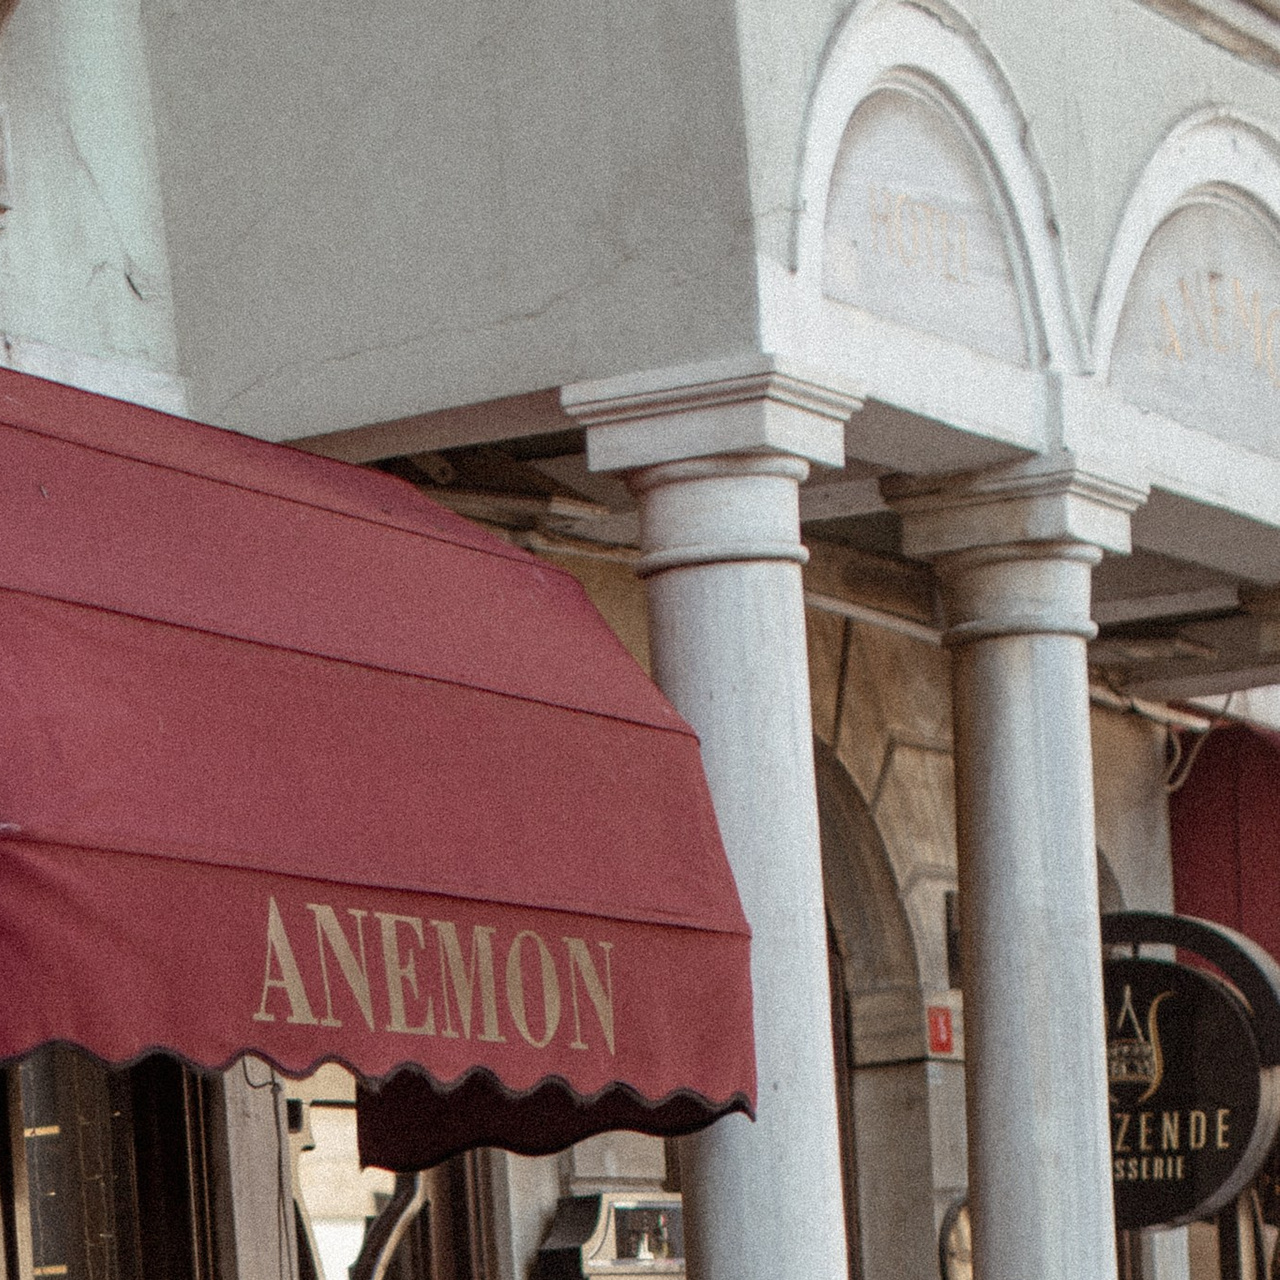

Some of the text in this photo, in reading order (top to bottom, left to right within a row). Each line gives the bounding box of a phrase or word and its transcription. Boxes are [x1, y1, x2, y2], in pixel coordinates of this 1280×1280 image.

[1150, 268, 1280, 389] ANEMO
[253, 896, 615, 1056] ANEMON
[1114, 1155, 1185, 1181] SSERIE
[1115, 1108, 1231, 1152] ZENDE
